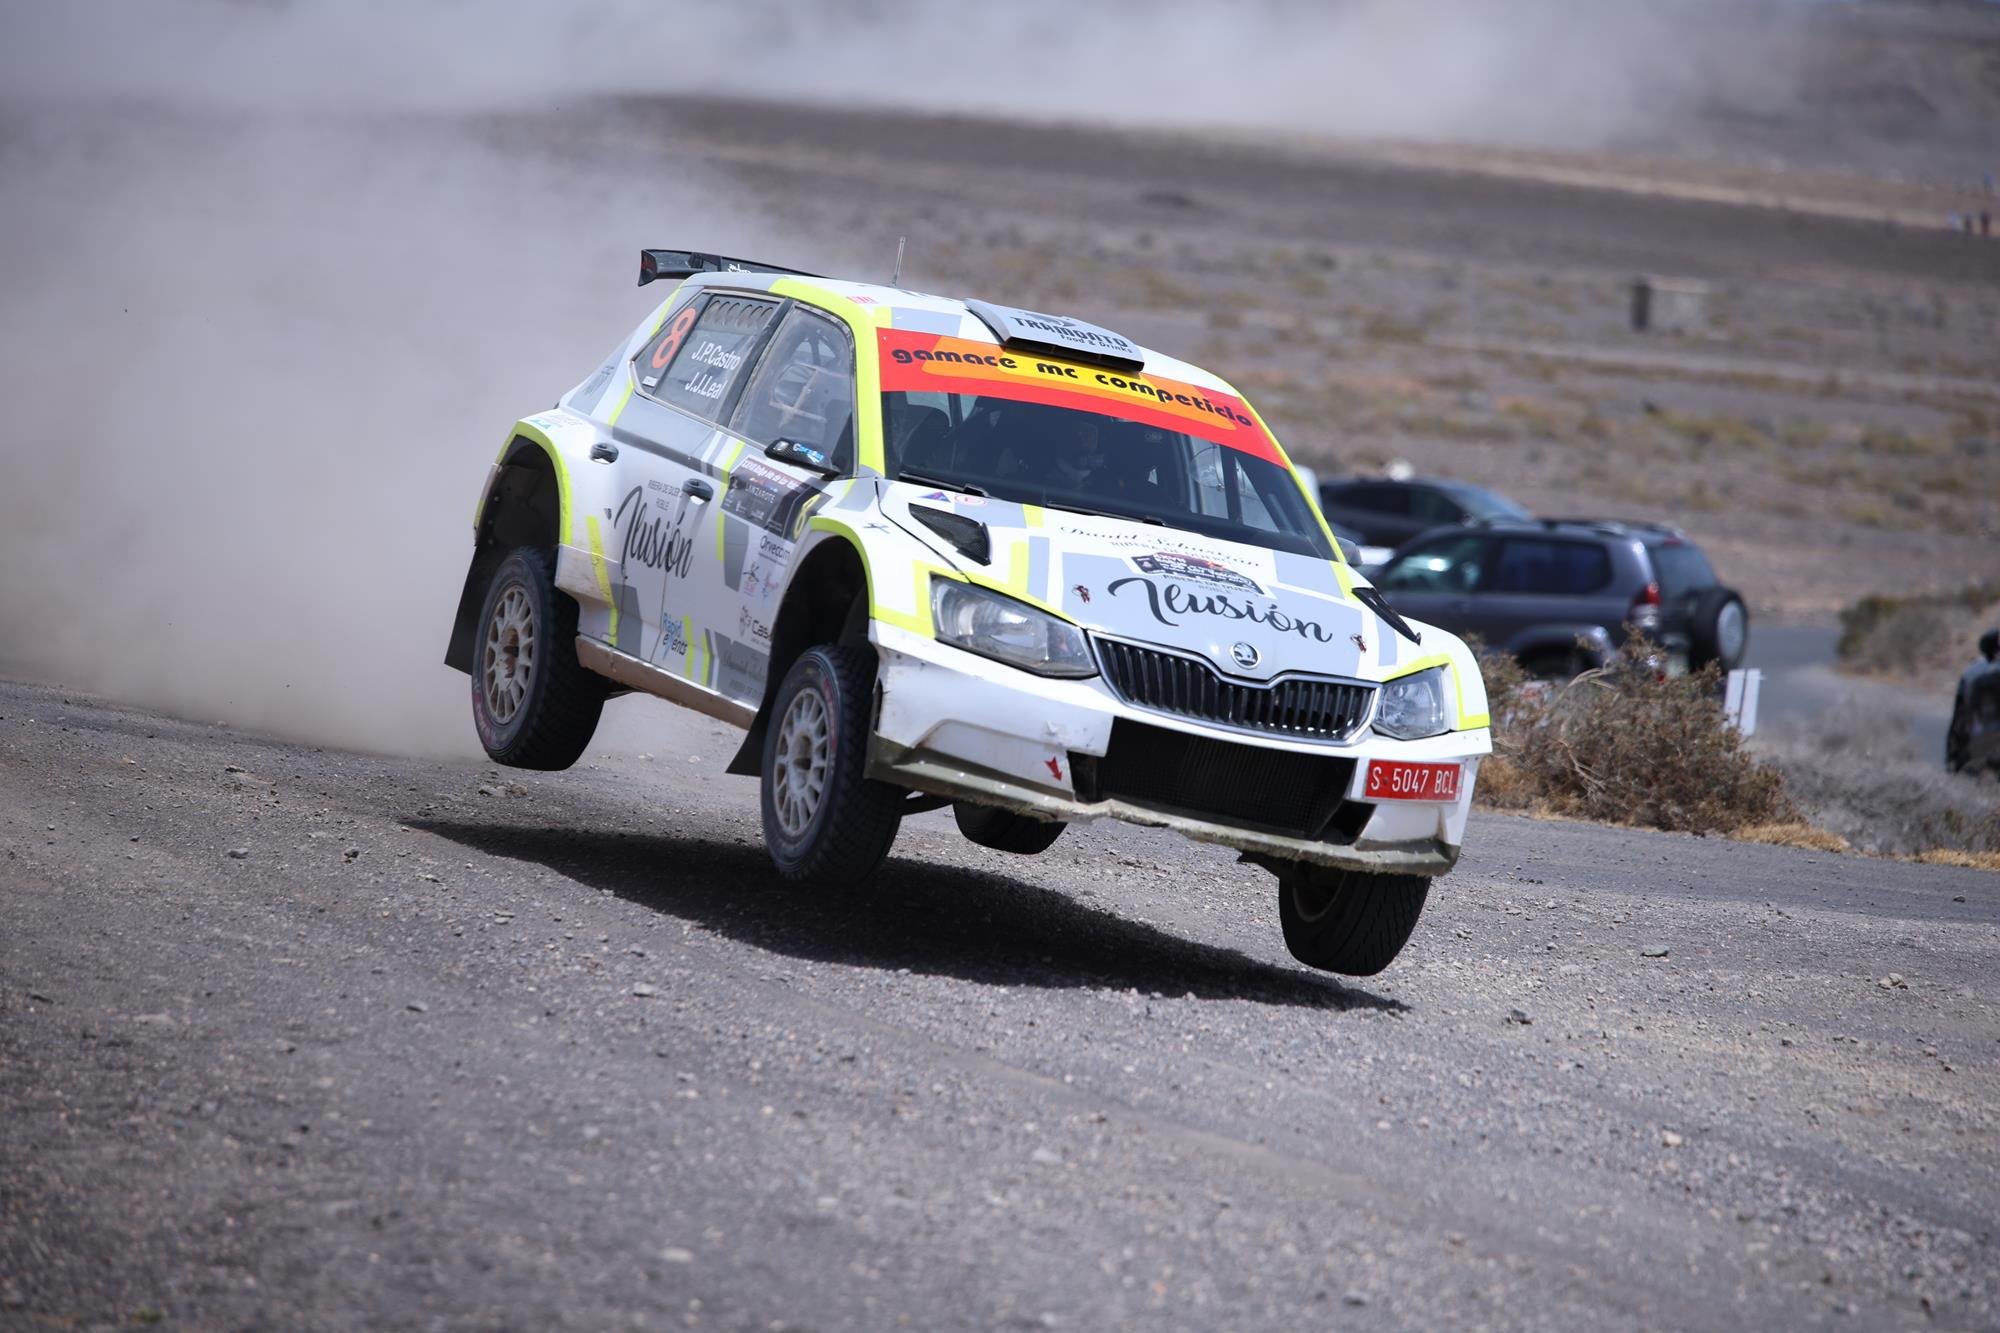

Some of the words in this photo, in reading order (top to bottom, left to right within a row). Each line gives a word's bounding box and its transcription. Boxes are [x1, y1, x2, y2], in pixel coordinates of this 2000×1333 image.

[651, 307, 697, 369] 8
[1010, 316, 1129, 348] TRAMONTO
[691, 340, 741, 370] J.P.Castro
[891, 349, 1018, 369] gamace
[1036, 361, 1079, 379] mc
[684, 371, 729, 400] J.J.Leal
[1107, 577, 1333, 643] Ilusión
[1370, 766, 1382, 791] S
[1392, 768, 1430, 793] 5047
[1434, 769, 1455, 795] BCL
